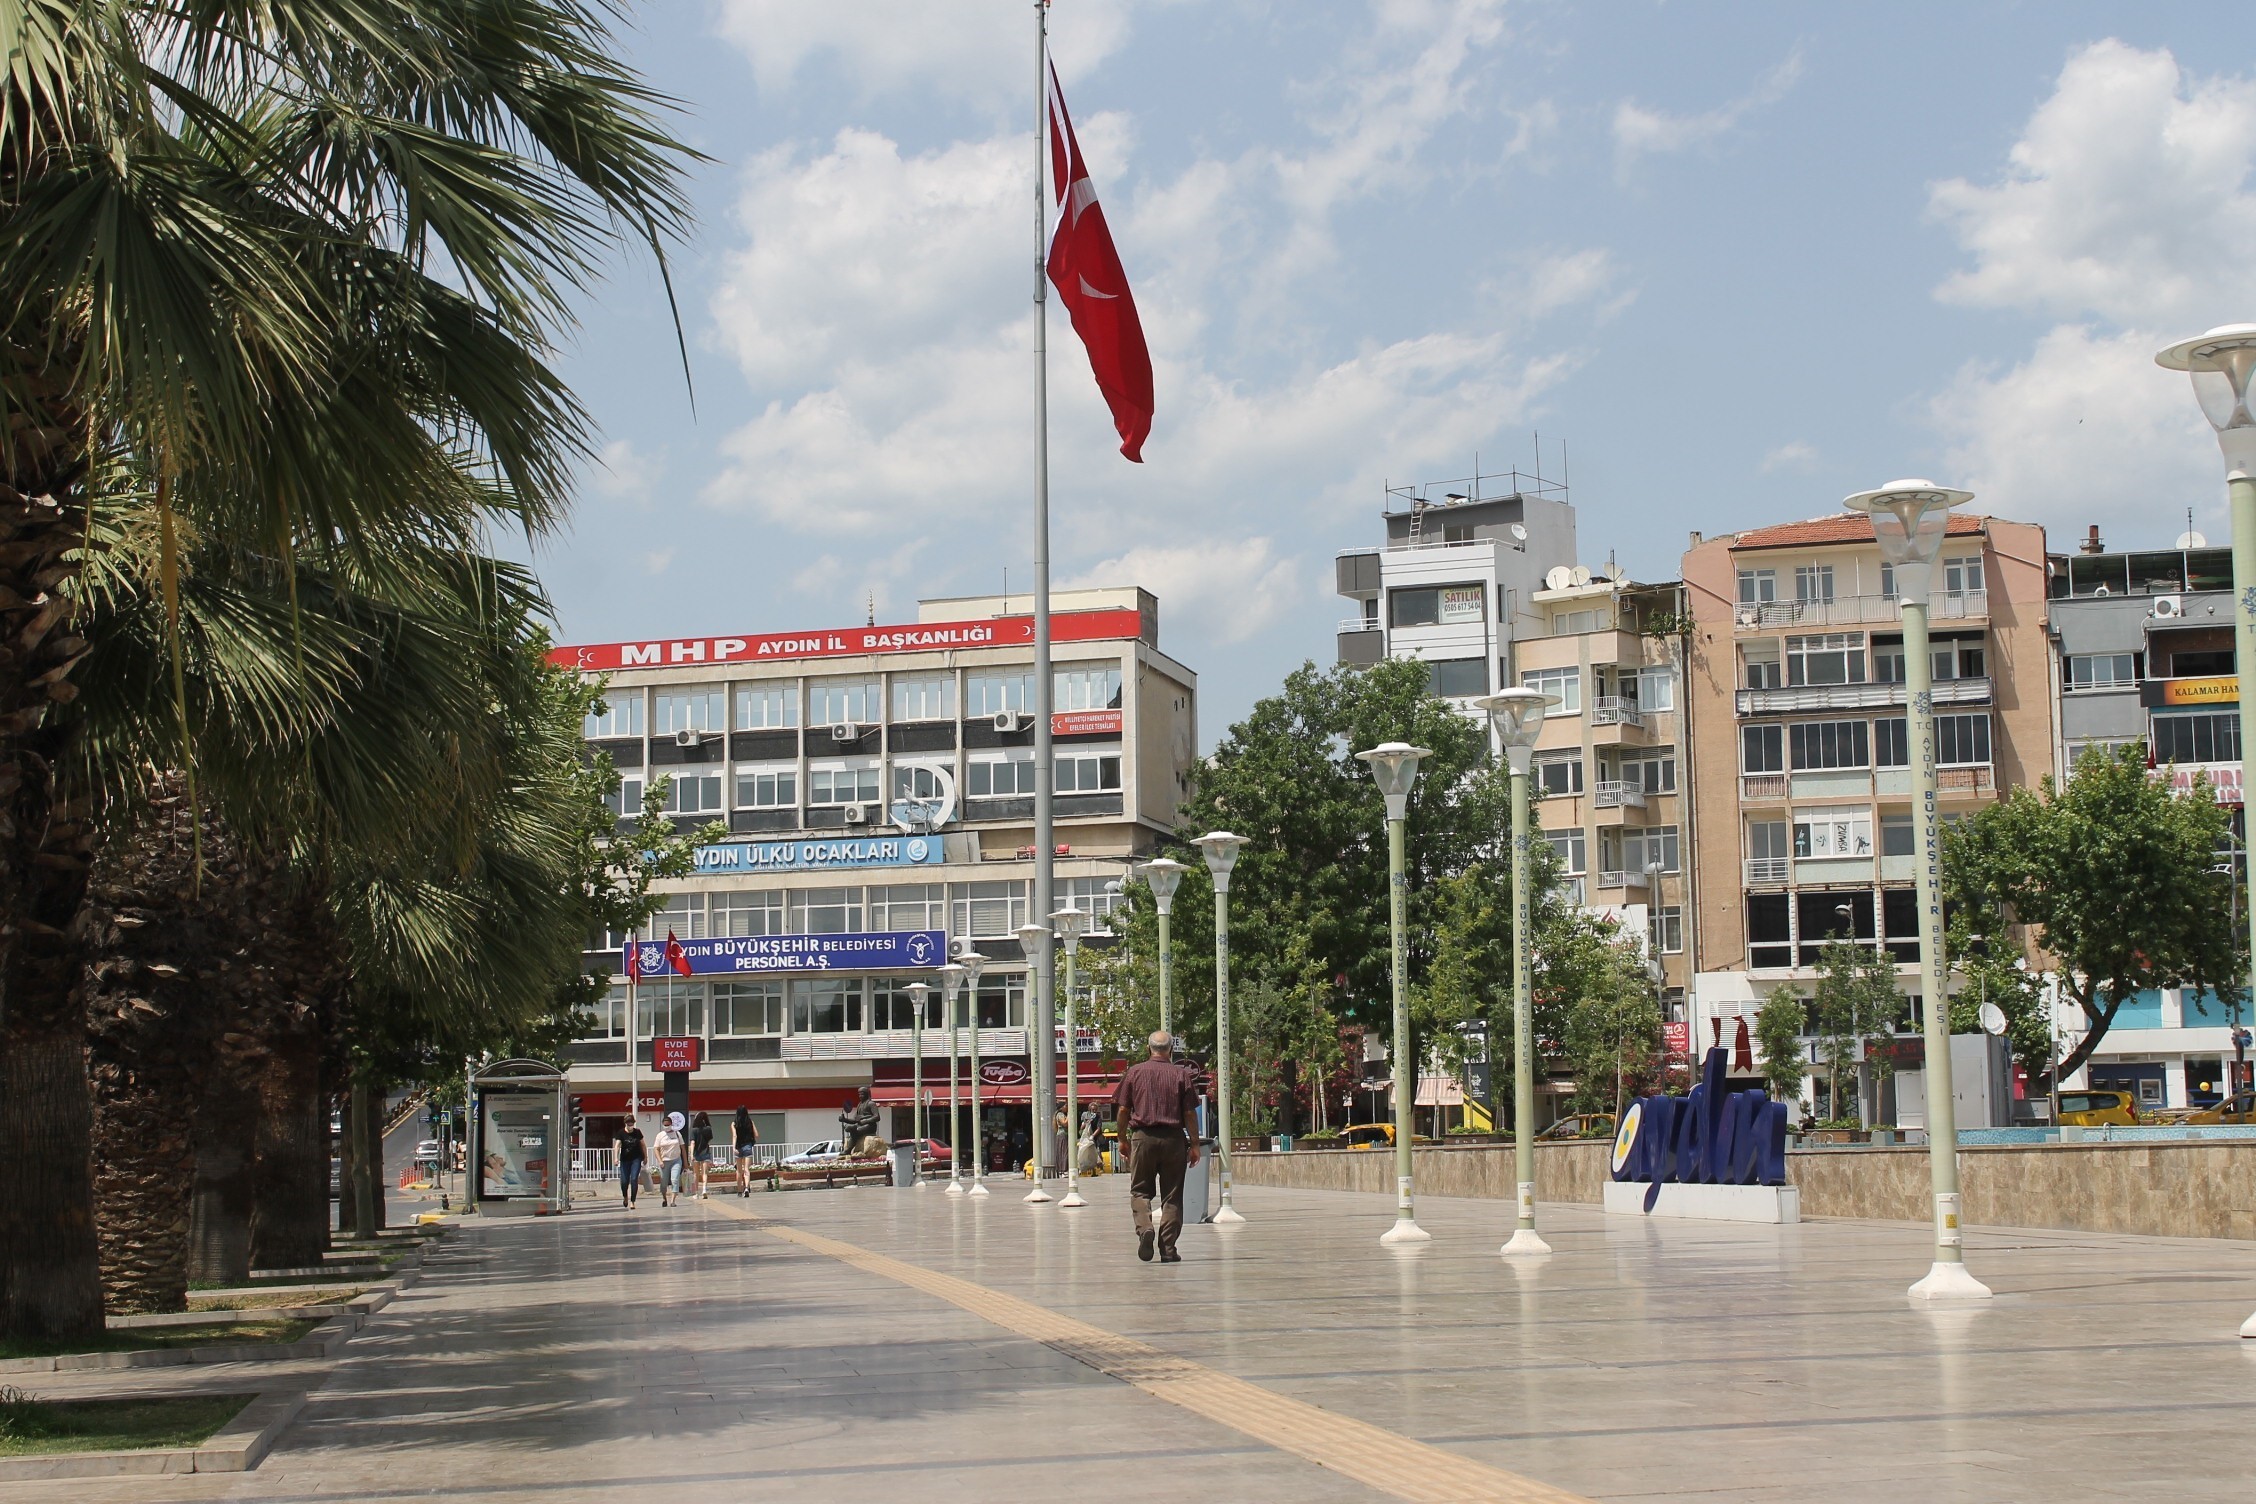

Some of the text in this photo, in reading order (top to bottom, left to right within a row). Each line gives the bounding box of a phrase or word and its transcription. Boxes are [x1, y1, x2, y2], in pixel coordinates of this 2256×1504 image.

[1444, 590, 1481, 604] SATILIK
[621, 624, 993, 666] MHP AYDIN İL BAŞKANLIĞI
[2174, 686, 2220, 697] KALAMAR
[1837, 824, 1848, 852] ZUMBA
[746, 840, 795, 863] ÜLKÜ
[803, 841, 899, 861] OCAKLARI
[714, 937, 820, 956] BÜYÜKŞEHİR
[823, 937, 896, 952] BELEDİYESİ
[735, 954, 831, 969] PERSONEL A.Ş.
[664, 1040, 689, 1048] EVDE
[667, 1050, 686, 1058] KAL
[660, 1060, 691, 1068] AYDIN
